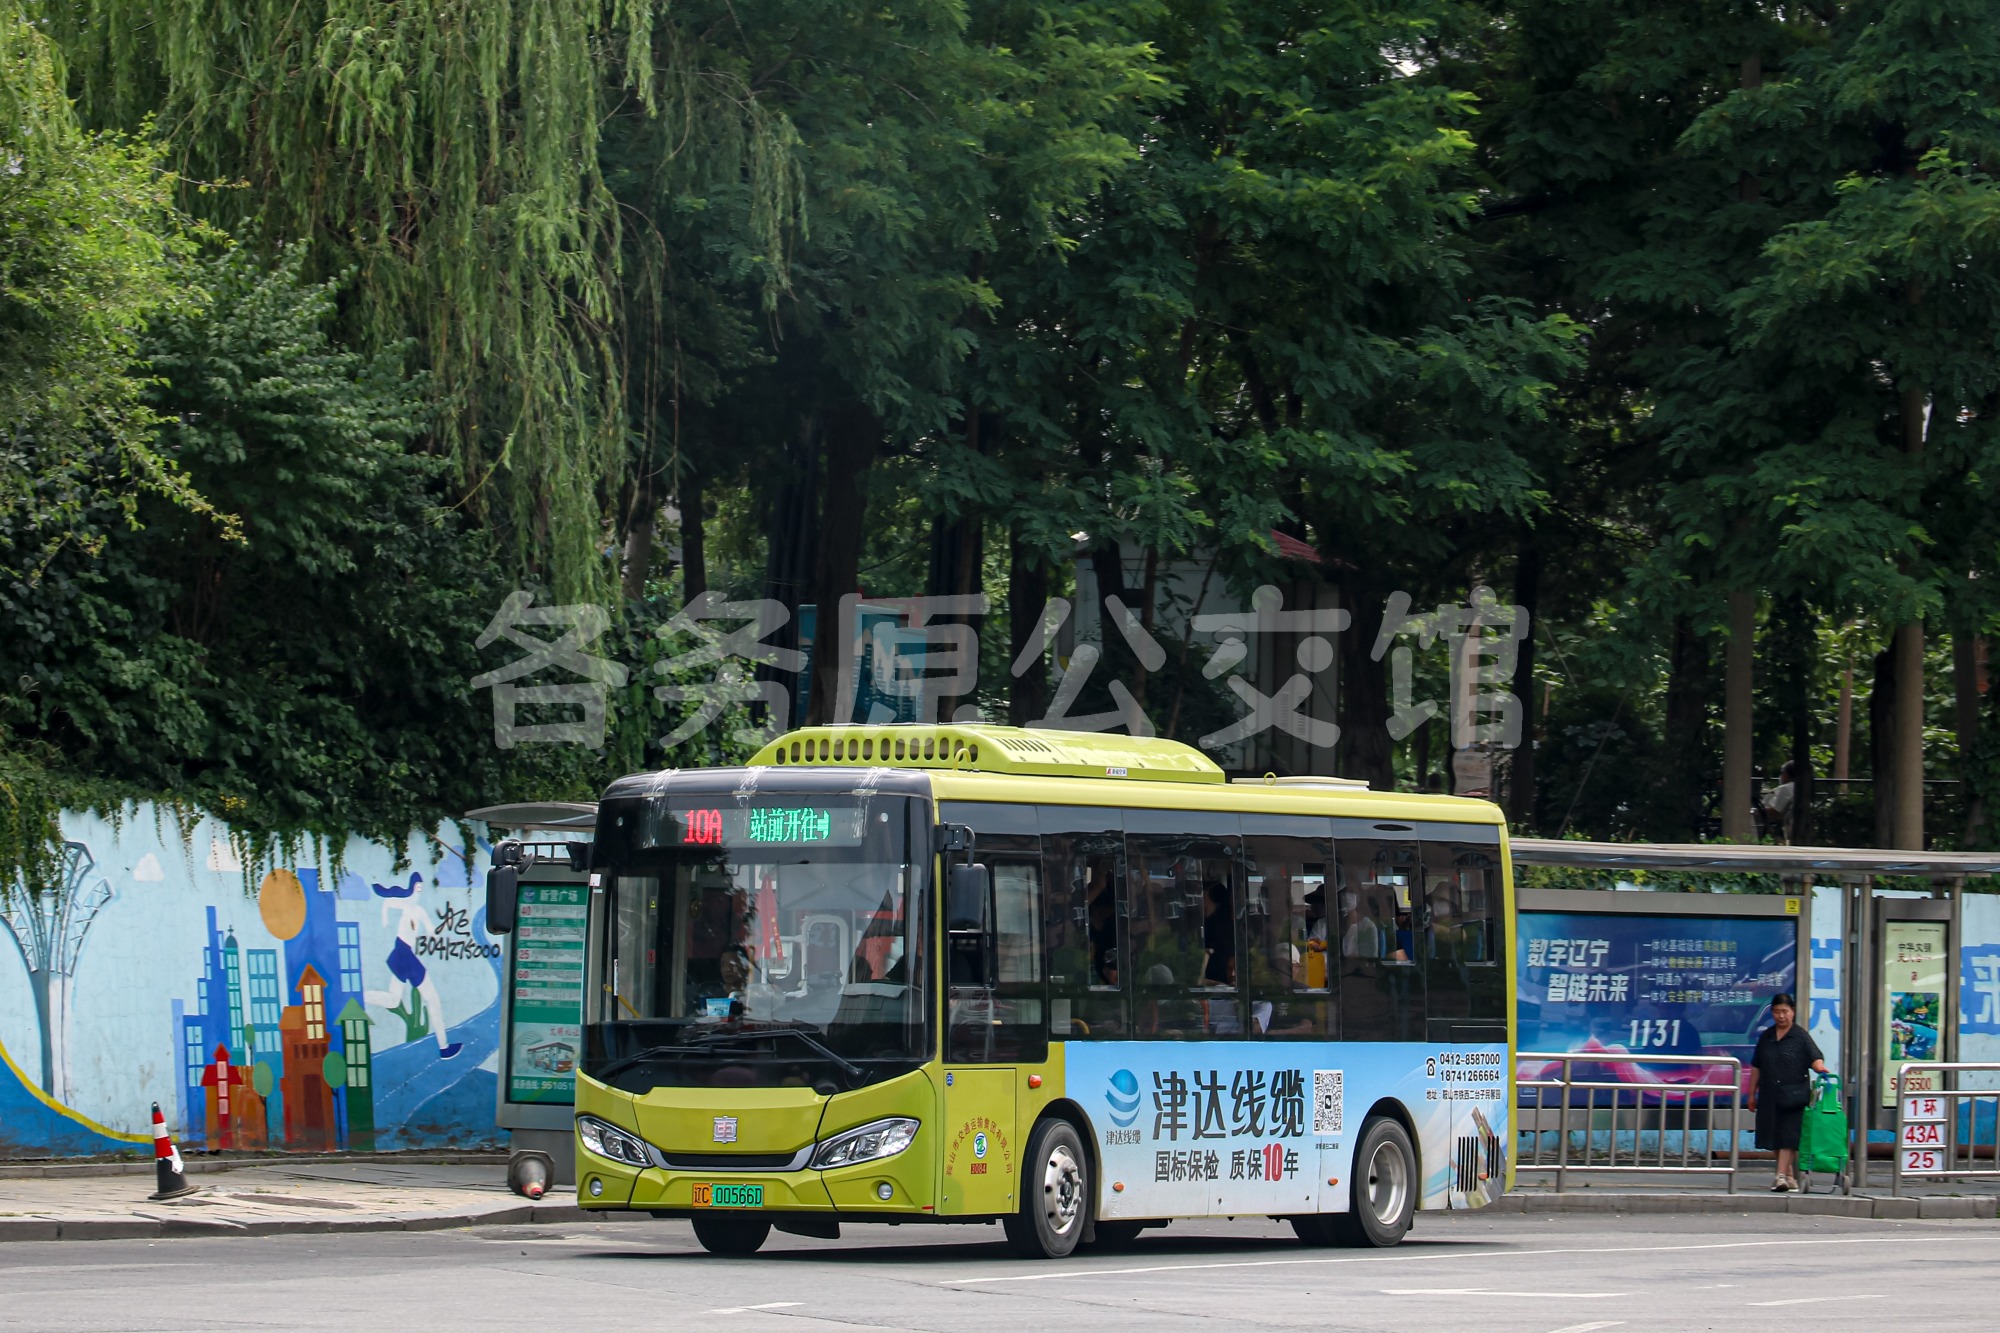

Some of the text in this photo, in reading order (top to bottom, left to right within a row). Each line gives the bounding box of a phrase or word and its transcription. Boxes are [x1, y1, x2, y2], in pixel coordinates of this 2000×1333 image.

[684, 809, 722, 844] 10A
[750, 808, 818, 842] 站前开往
[1527, 938, 1610, 968] 数字辽宁
[1629, 1019, 1681, 1047] 1131
[1440, 1053, 1500, 1065] 0412-8587000
[1440, 1070, 1500, 1082] 18741266664
[1152, 1069, 1305, 1141] 津达线缆
[1106, 1130, 1141, 1145] 津达线缆
[1905, 1125, 1939, 1143] 43A
[1155, 1143, 1299, 1182] 国标保检 质保10年
[1908, 1152, 1934, 1169] 25
